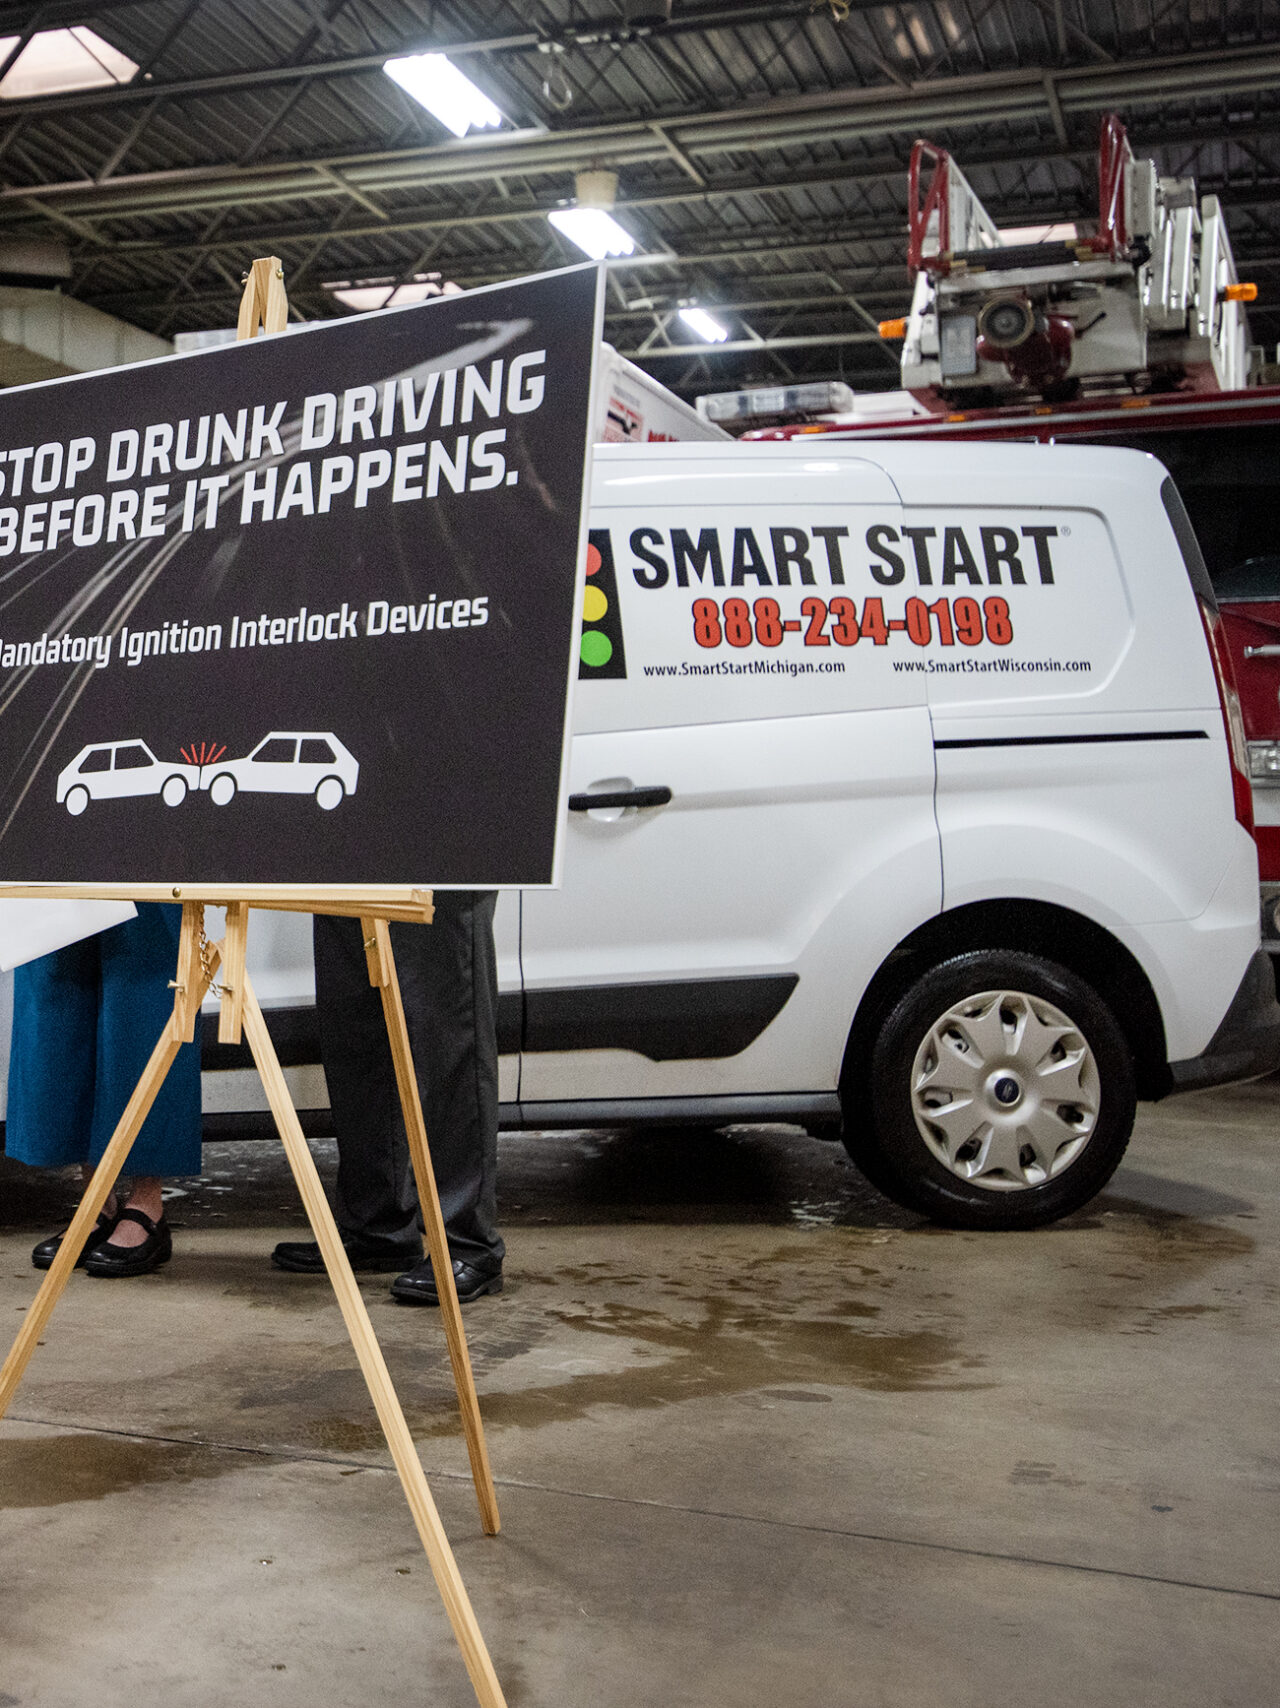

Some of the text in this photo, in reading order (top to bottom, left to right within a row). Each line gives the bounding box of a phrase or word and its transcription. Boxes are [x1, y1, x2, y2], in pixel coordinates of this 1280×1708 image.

[106, 401, 288, 482] DRUNK
[301, 349, 546, 450] DRIVING
[182, 475, 229, 533] IT
[240, 428, 519, 524] HAPPENS.
[629, 525, 1058, 589] SMART START
[119, 620, 222, 666] Ignition
[230, 603, 358, 648] Interlock
[366, 594, 489, 636] Devices
[692, 596, 1013, 648] 888-234-0198
[643, 660, 846, 677] www.SmartStartMichigan.com
[893, 659, 1091, 673] www.SmartStartWisconsin.com
